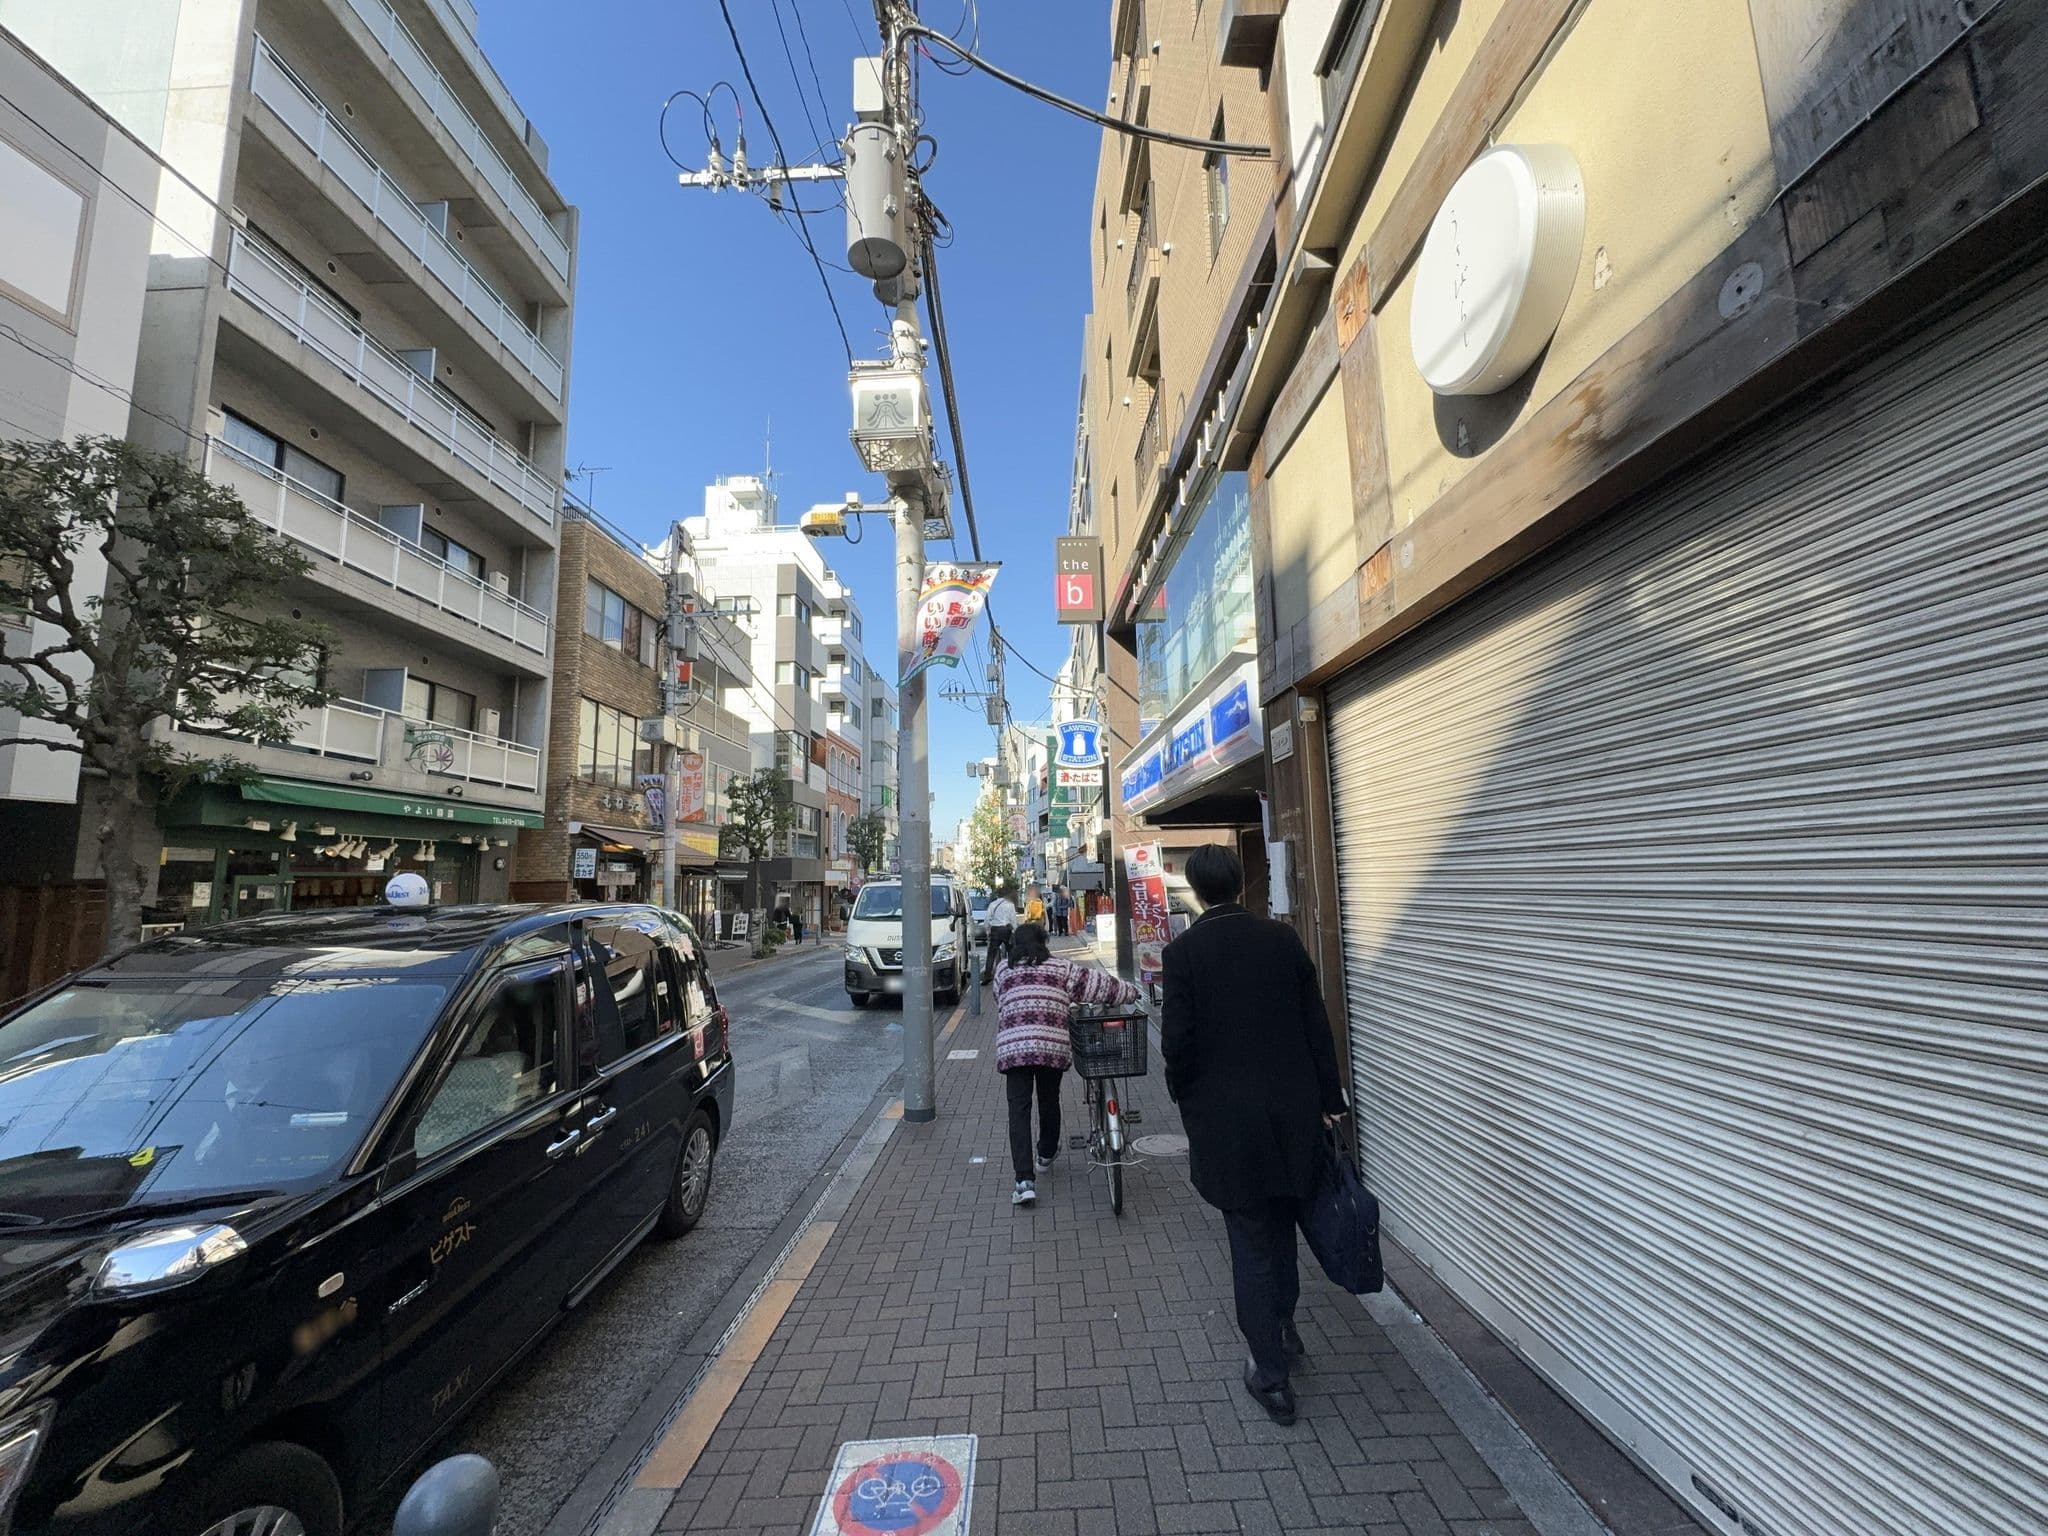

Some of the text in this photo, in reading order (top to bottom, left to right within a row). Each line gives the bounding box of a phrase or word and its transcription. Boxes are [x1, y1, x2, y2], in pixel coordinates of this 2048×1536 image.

[1062, 559, 1089, 571] the
[1062, 724, 1097, 733] LAWSON
[1164, 717, 1206, 776] LAWSON
[1062, 753, 1098, 763] STATION
[1060, 772, 1099, 783] 酒・たばこ
